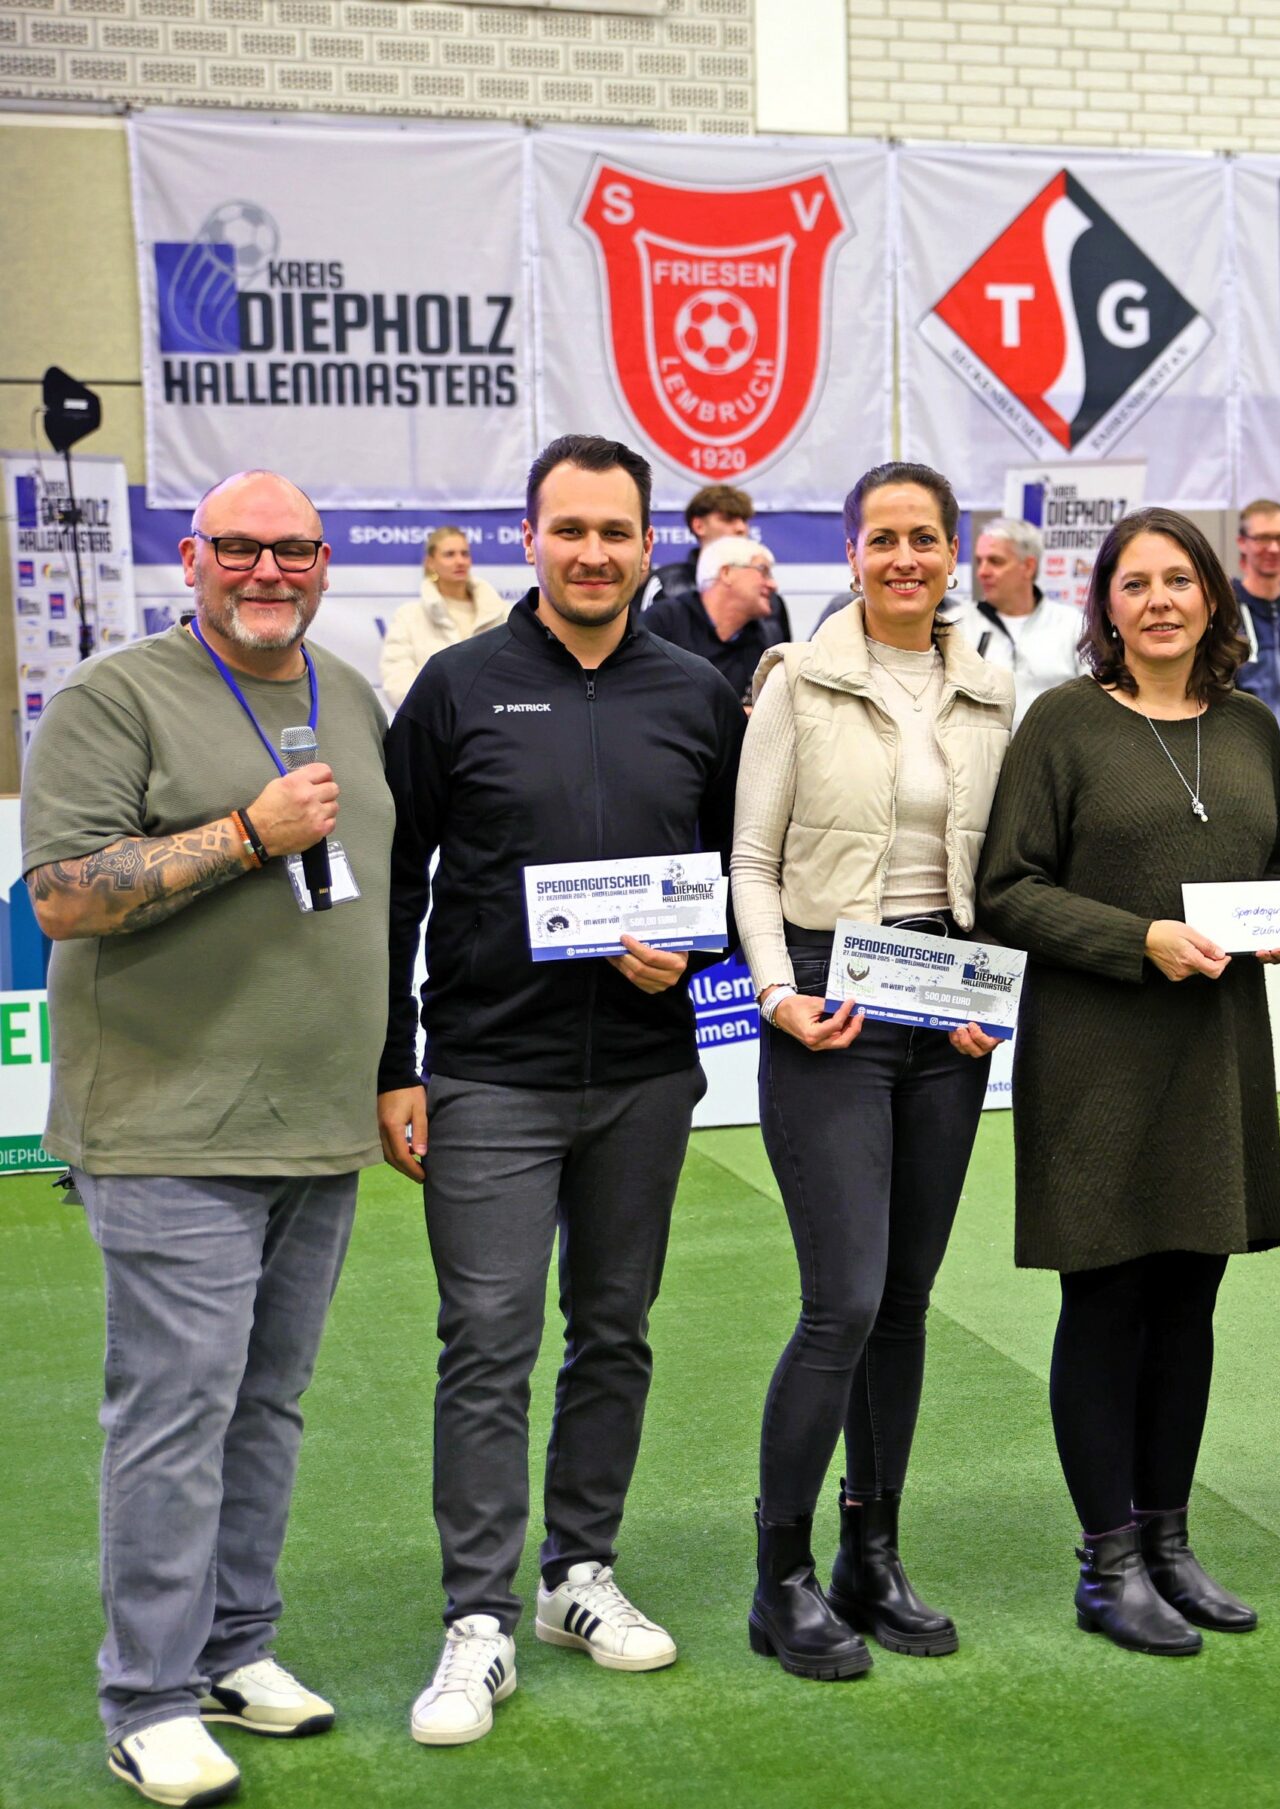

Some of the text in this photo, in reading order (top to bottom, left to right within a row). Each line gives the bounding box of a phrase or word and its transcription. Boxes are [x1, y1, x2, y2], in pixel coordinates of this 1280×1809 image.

[269, 261, 344, 288] KREIS
[653, 259, 777, 288] FRIESEN
[239, 291, 515, 356] DIEPHOLZ
[163, 360, 517, 407] HALLENMASTERS
[660, 356, 776, 423] LEMBRUCH
[689, 447, 747, 471] 1920
[506, 702, 552, 714] PATRICK
[536, 873, 651, 895] SPENDENGUTSCHEIN
[672, 883, 714, 895] DIEPHOLZ
[662, 892, 714, 903] HALLENMASTERS
[843, 936, 955, 966] SPENDENGUTSCHEIN
[961, 978, 1012, 994] HALLENMASTERS
[974, 971, 1014, 986] DIEPHOLZ
[924, 990, 951, 1005] 500,00
[951, 994, 971, 1007] EURO
